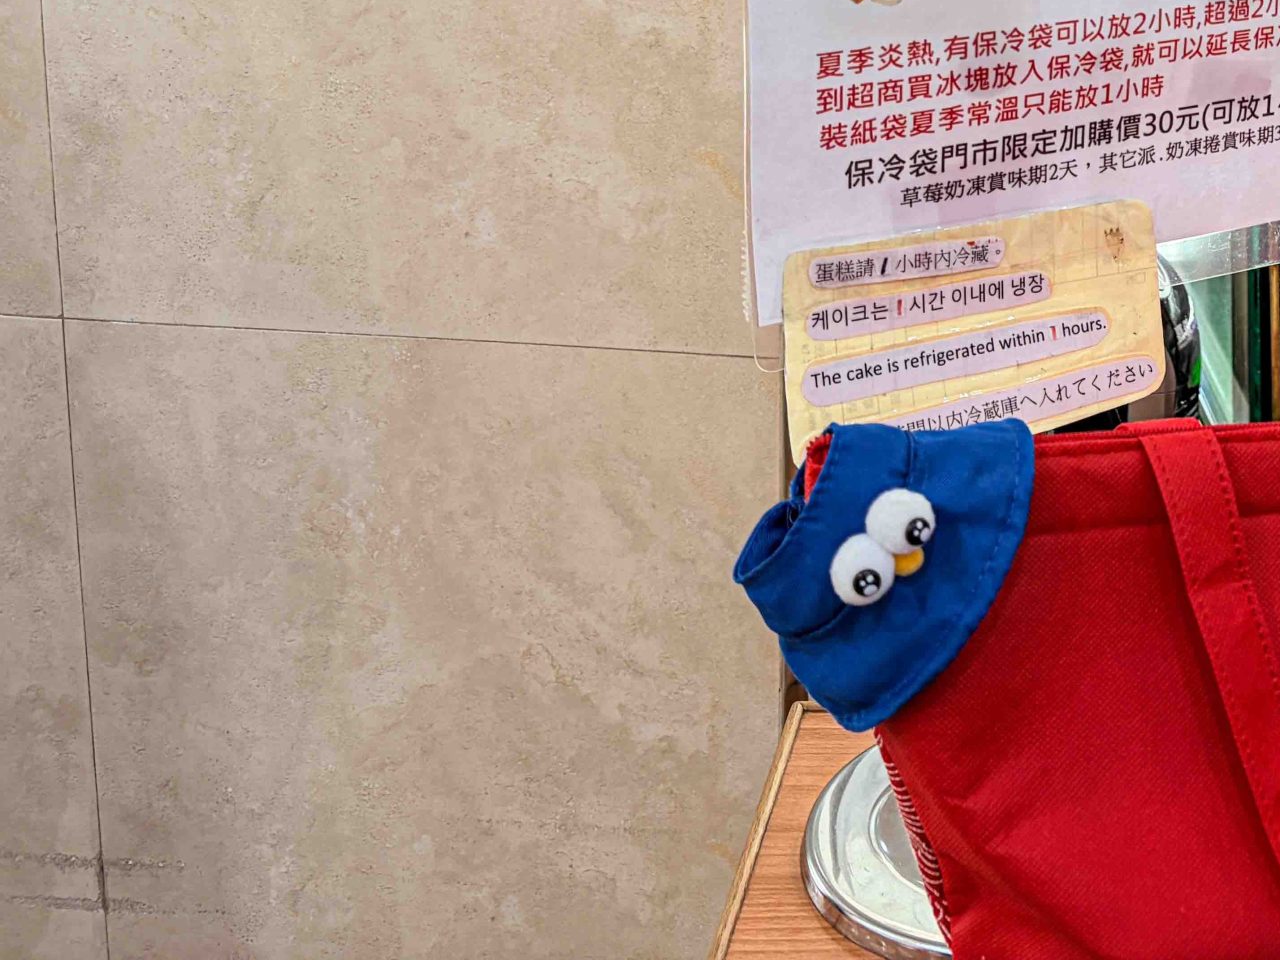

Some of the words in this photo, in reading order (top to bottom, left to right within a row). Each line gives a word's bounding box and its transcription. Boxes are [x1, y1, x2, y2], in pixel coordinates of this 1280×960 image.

[814, 256, 875, 283] 蛋糕請
[811, 301, 889, 331] 케이크는
[908, 290, 946, 313] 시간
[951, 280, 1005, 306] 이내에
[1010, 273, 1045, 299] 냉장
[811, 371, 842, 389] The
[845, 363, 883, 382] cake
[887, 357, 900, 374] is
[903, 340, 996, 371] refrigerated
[999, 328, 1045, 352] within
[1061, 318, 1107, 338] hours.
